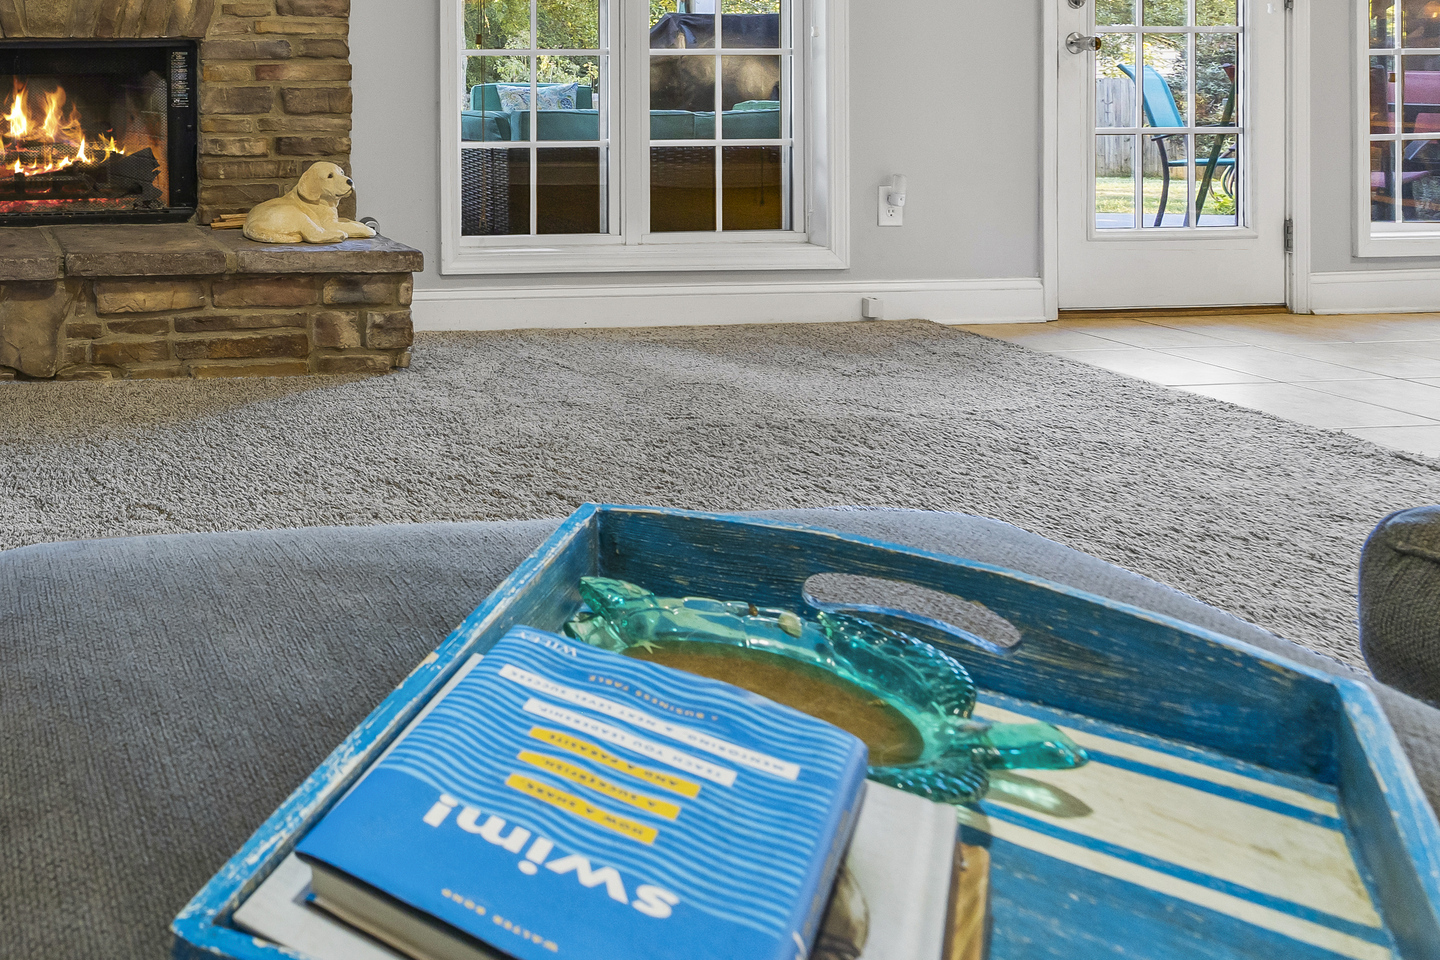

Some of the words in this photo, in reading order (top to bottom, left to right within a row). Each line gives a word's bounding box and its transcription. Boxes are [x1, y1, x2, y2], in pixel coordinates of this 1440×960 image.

[515, 631, 578, 657] WILEY
[634, 690, 705, 720] BUSINESS
[421, 793, 680, 920] swim!
[492, 914, 559, 952] WALTER
